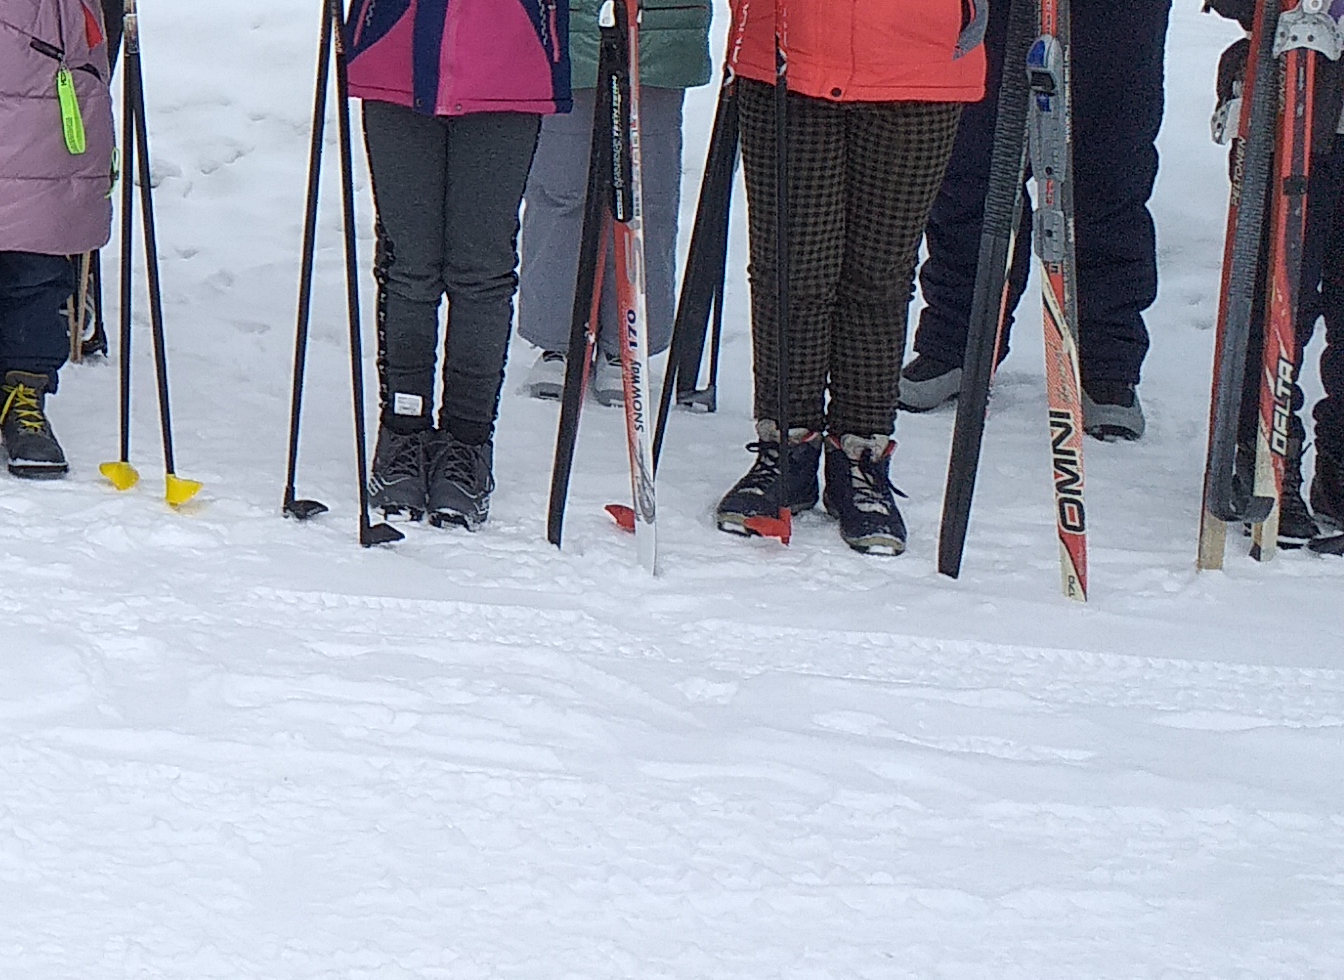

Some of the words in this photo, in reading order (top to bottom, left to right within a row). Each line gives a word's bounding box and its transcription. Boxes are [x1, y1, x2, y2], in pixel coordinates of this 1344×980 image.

[626, 309, 637, 351] 170
[1271, 357, 1294, 457] DELTA
[1048, 409, 1086, 536] OMNI
